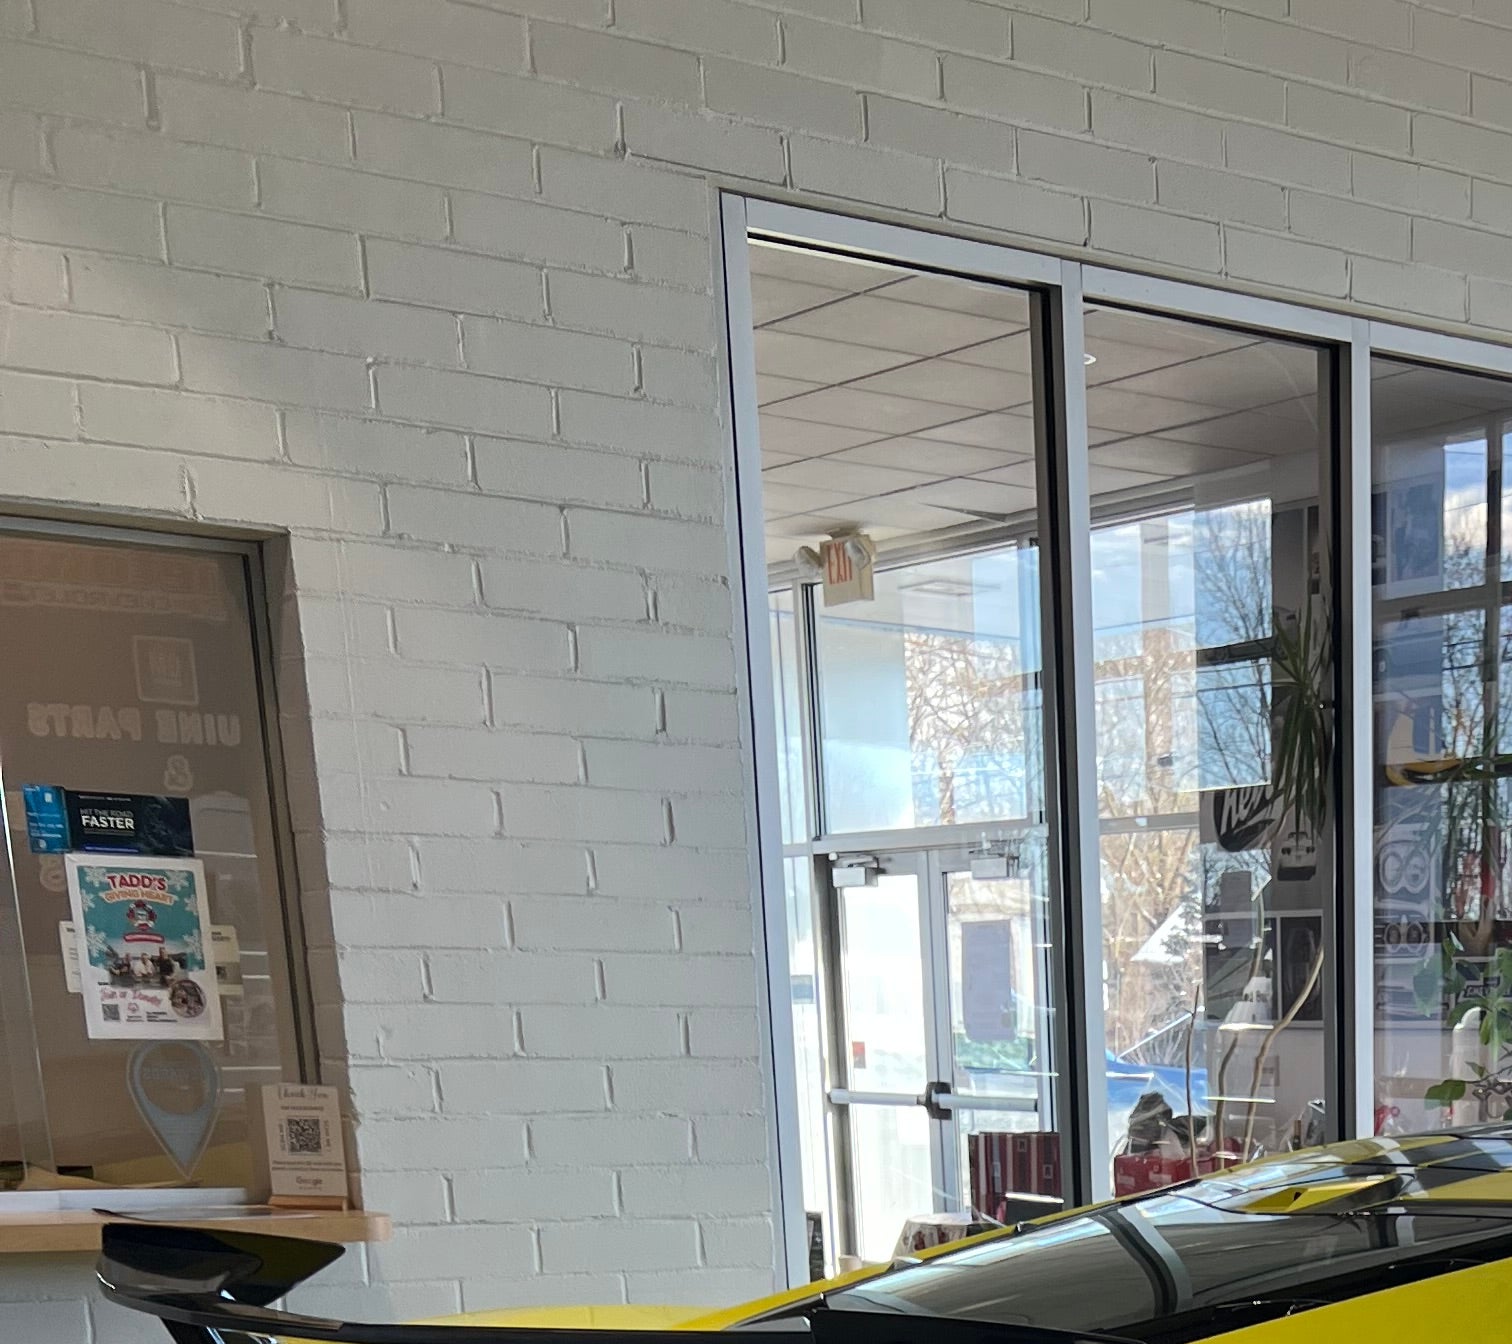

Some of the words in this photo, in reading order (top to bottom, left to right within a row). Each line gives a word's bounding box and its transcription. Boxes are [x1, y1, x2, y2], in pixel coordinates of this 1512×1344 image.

[82, 816, 135, 829] FASTER
[106, 874, 167, 891] TADD'S
[105, 890, 139, 902] GIVING
[142, 891, 174, 904] HEART
